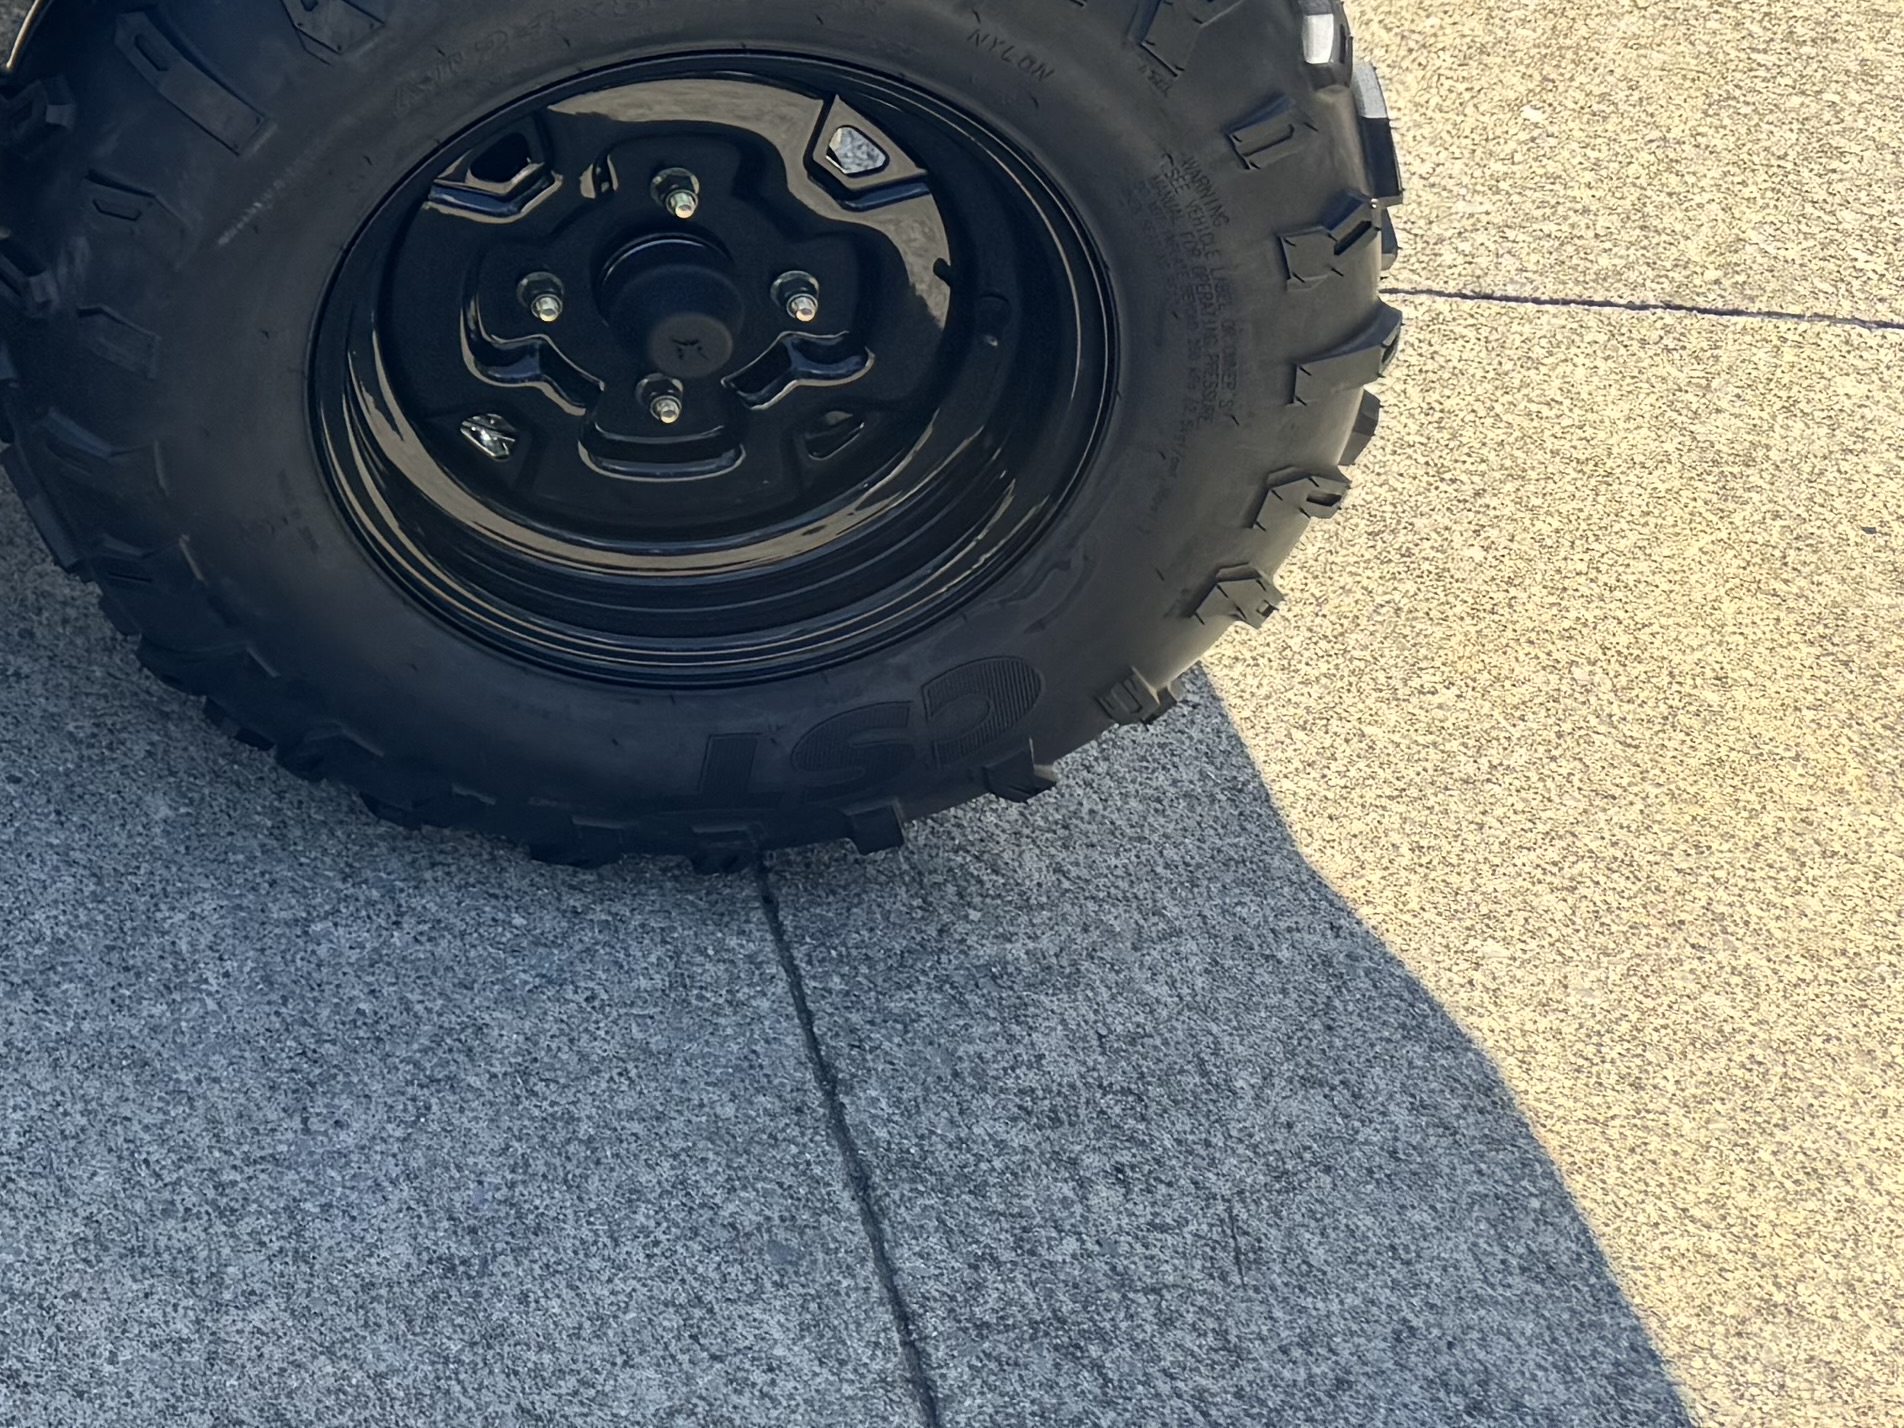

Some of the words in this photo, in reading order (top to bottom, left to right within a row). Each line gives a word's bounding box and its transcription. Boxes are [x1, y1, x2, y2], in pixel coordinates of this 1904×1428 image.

[964, 24, 1057, 86] NYLON
[1179, 157, 1229, 227] WARNING
[648, 655, 1043, 811] CST
